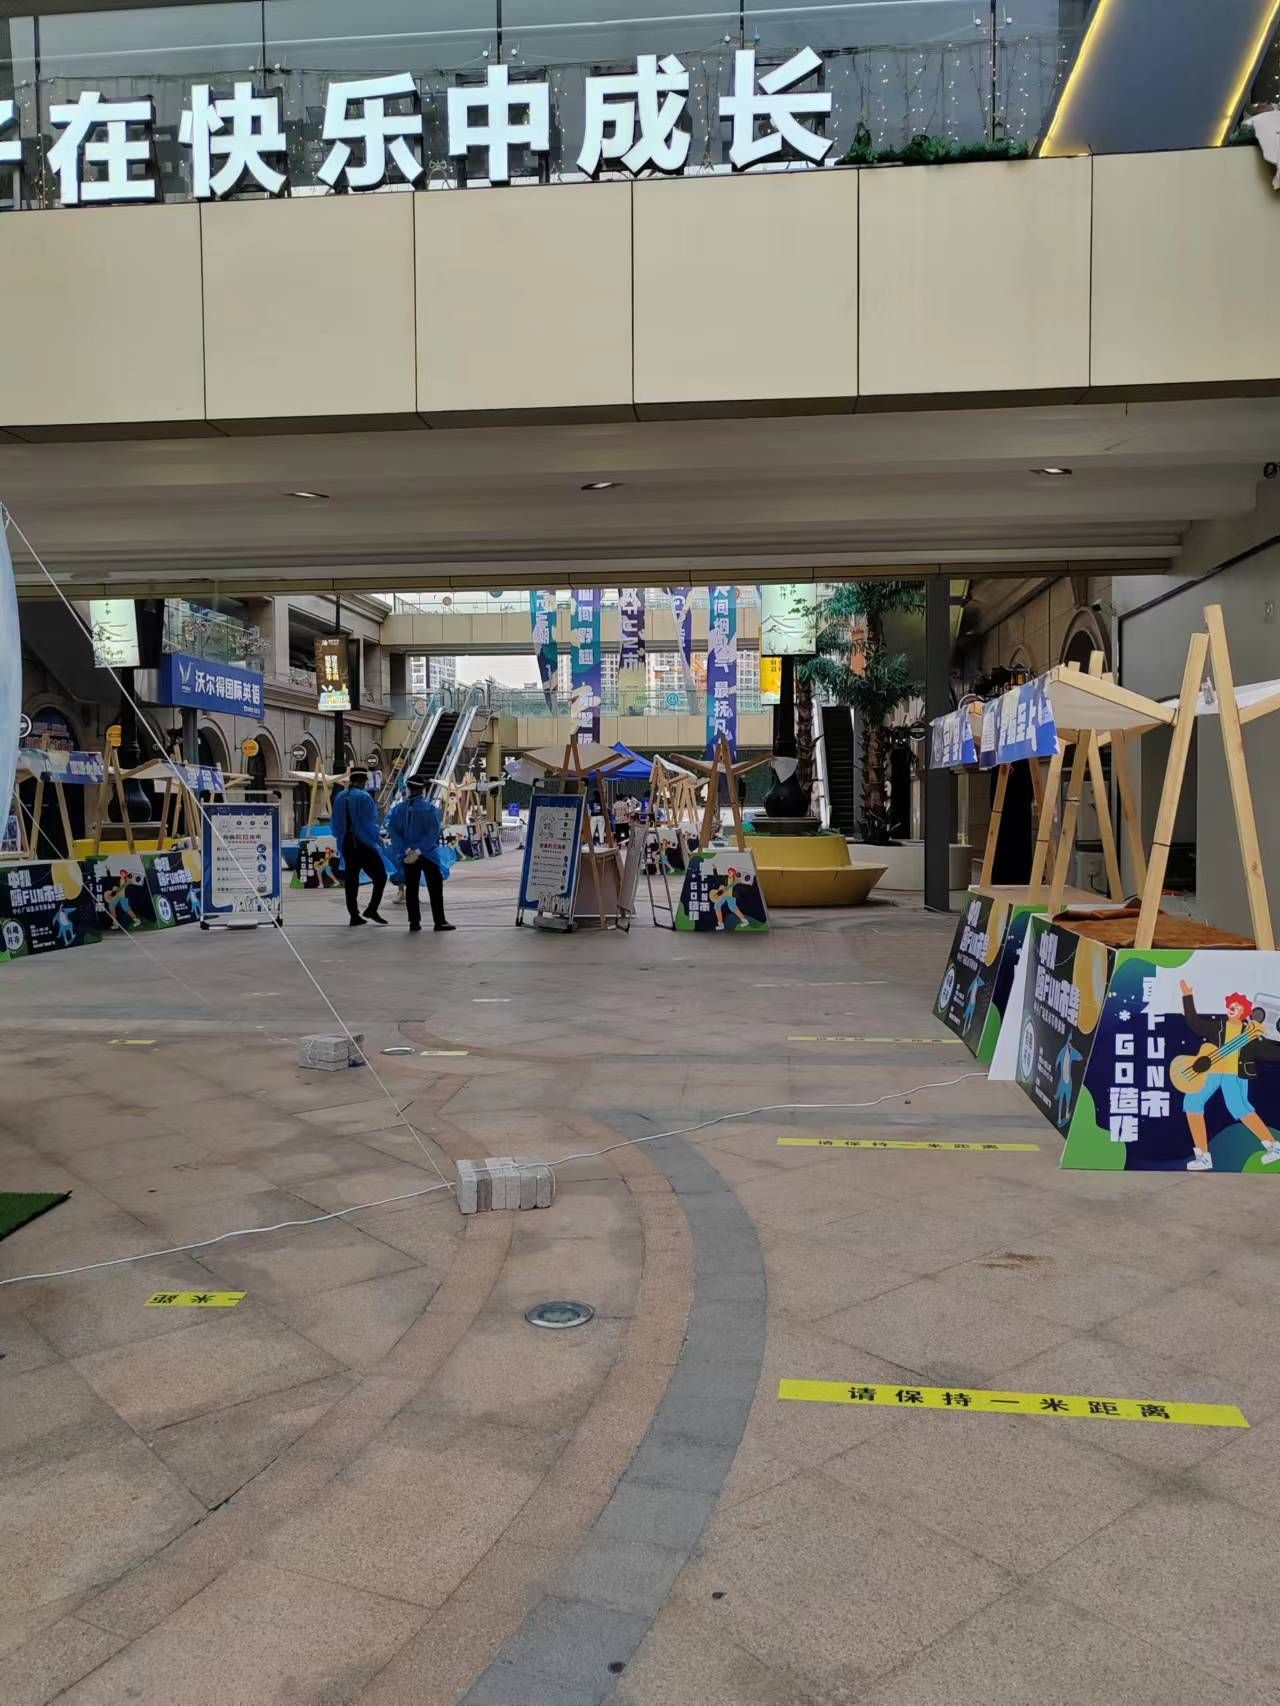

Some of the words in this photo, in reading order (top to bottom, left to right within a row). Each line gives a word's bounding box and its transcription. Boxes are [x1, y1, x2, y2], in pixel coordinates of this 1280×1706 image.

[0, 47, 834, 206] 在快乐中成长
[195, 670, 260, 705] 沃尔得国际英语
[1109, 1033, 1139, 1142] GO造作
[847, 1386, 1172, 1420] 请保持一米距离
